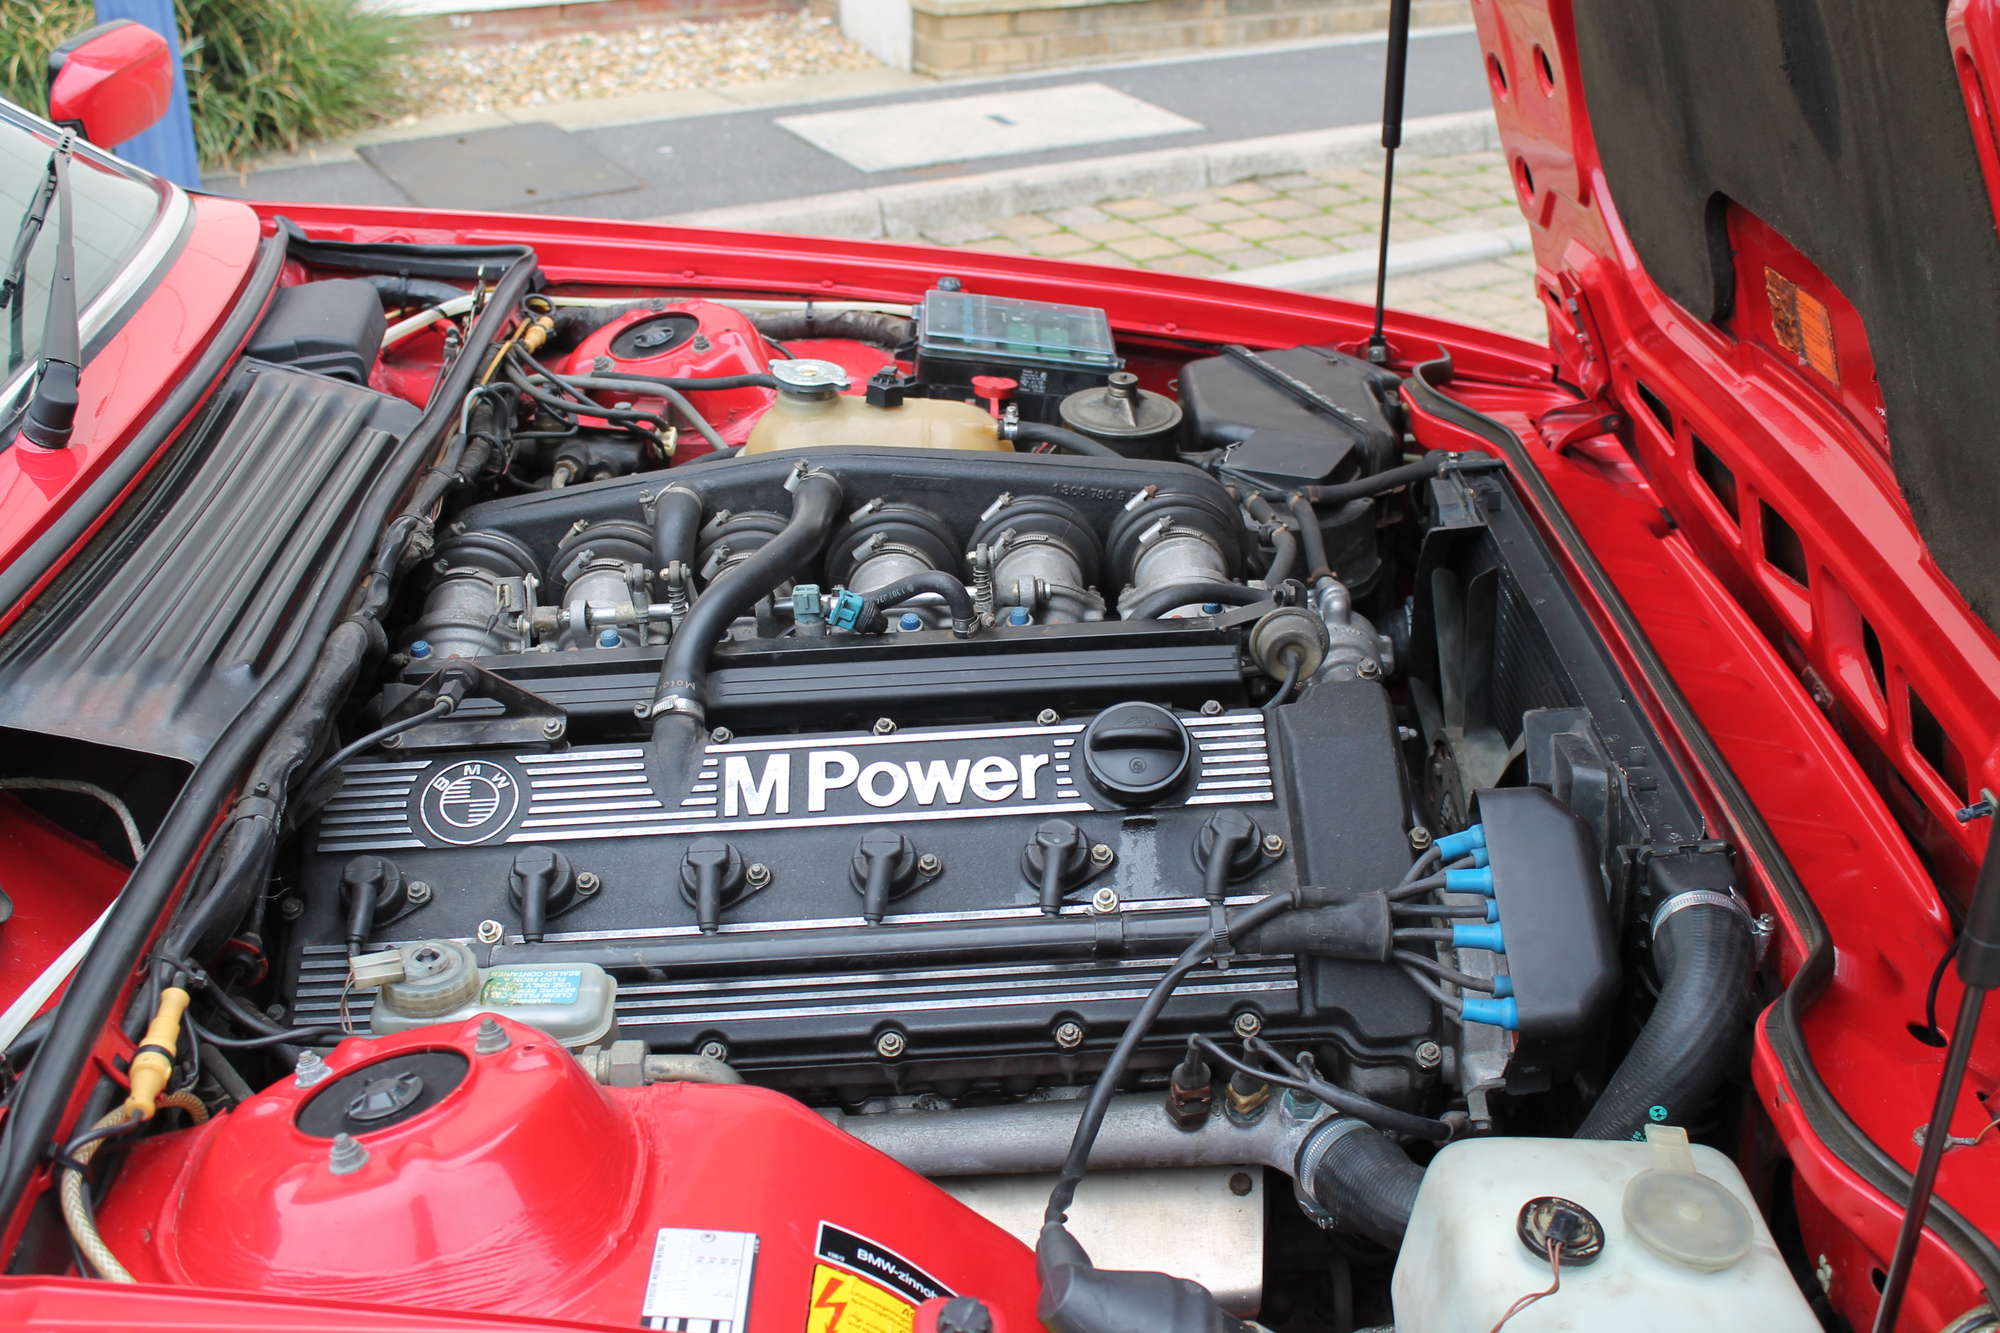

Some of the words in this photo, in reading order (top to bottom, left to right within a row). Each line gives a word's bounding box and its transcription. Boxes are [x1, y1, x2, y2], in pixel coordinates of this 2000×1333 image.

[432, 764, 511, 792] BMW
[724, 753, 791, 817] M
[808, 750, 1049, 812] Power
